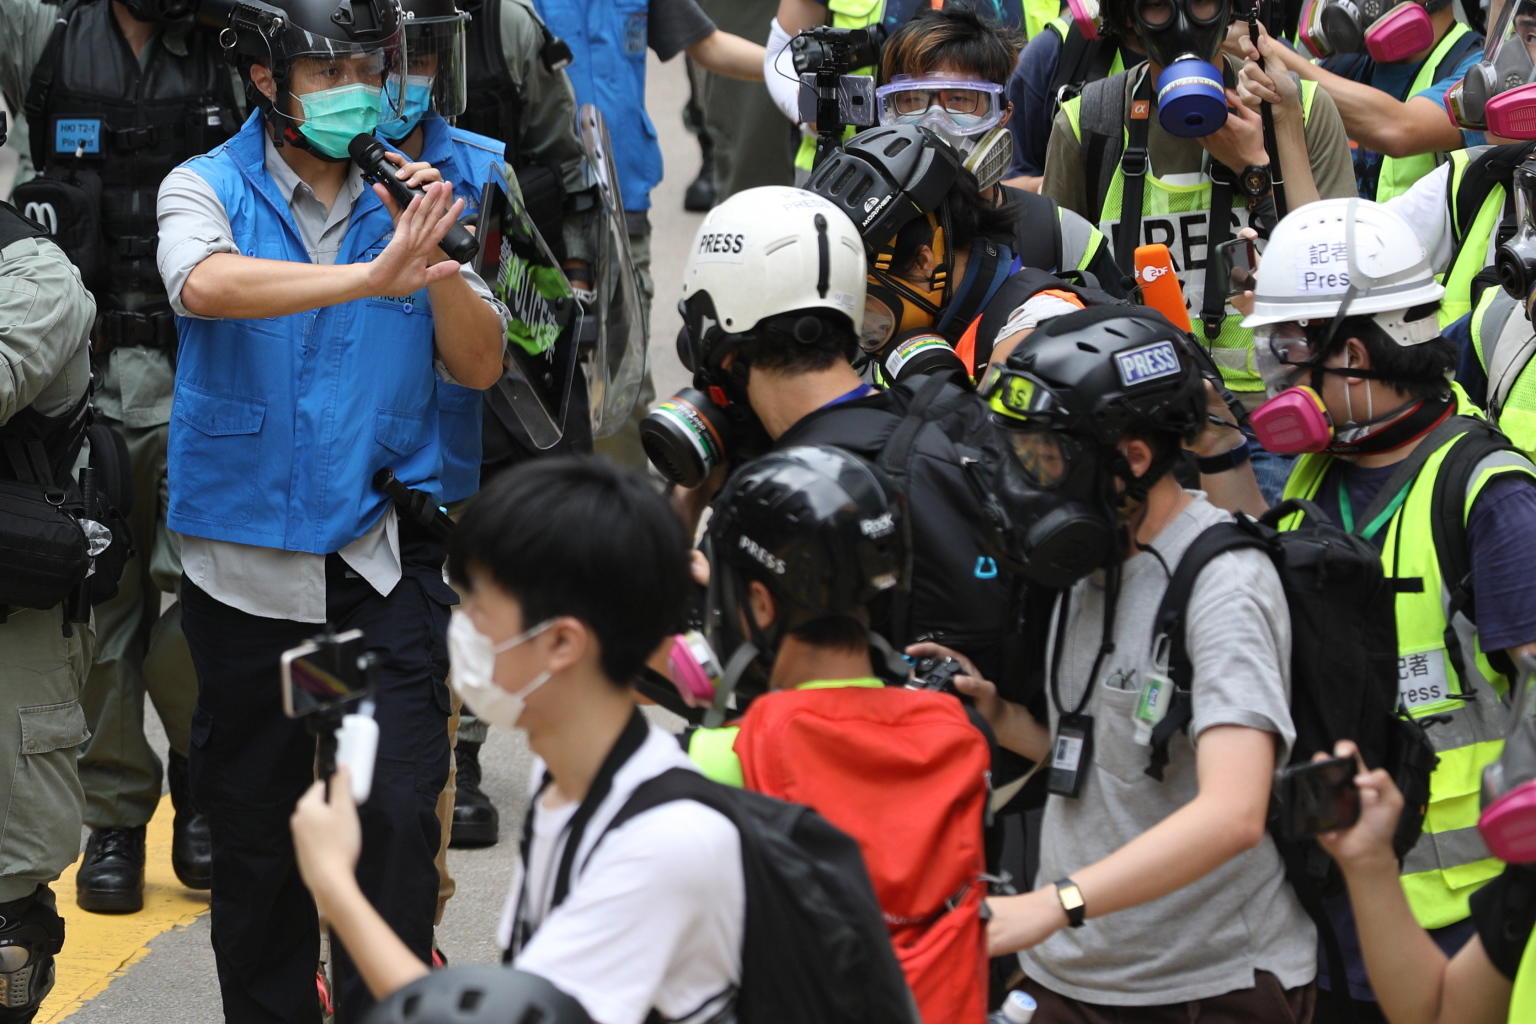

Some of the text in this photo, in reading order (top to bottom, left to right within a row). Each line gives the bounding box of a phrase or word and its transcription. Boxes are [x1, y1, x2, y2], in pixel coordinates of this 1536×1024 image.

[862, 194, 893, 227] MORPHER
[698, 233, 744, 254] PRESS
[1309, 241, 1349, 265] 記者
[1122, 345, 1176, 380] PRESS
[739, 534, 786, 574] PRESS
[1399, 684, 1441, 703] ress
